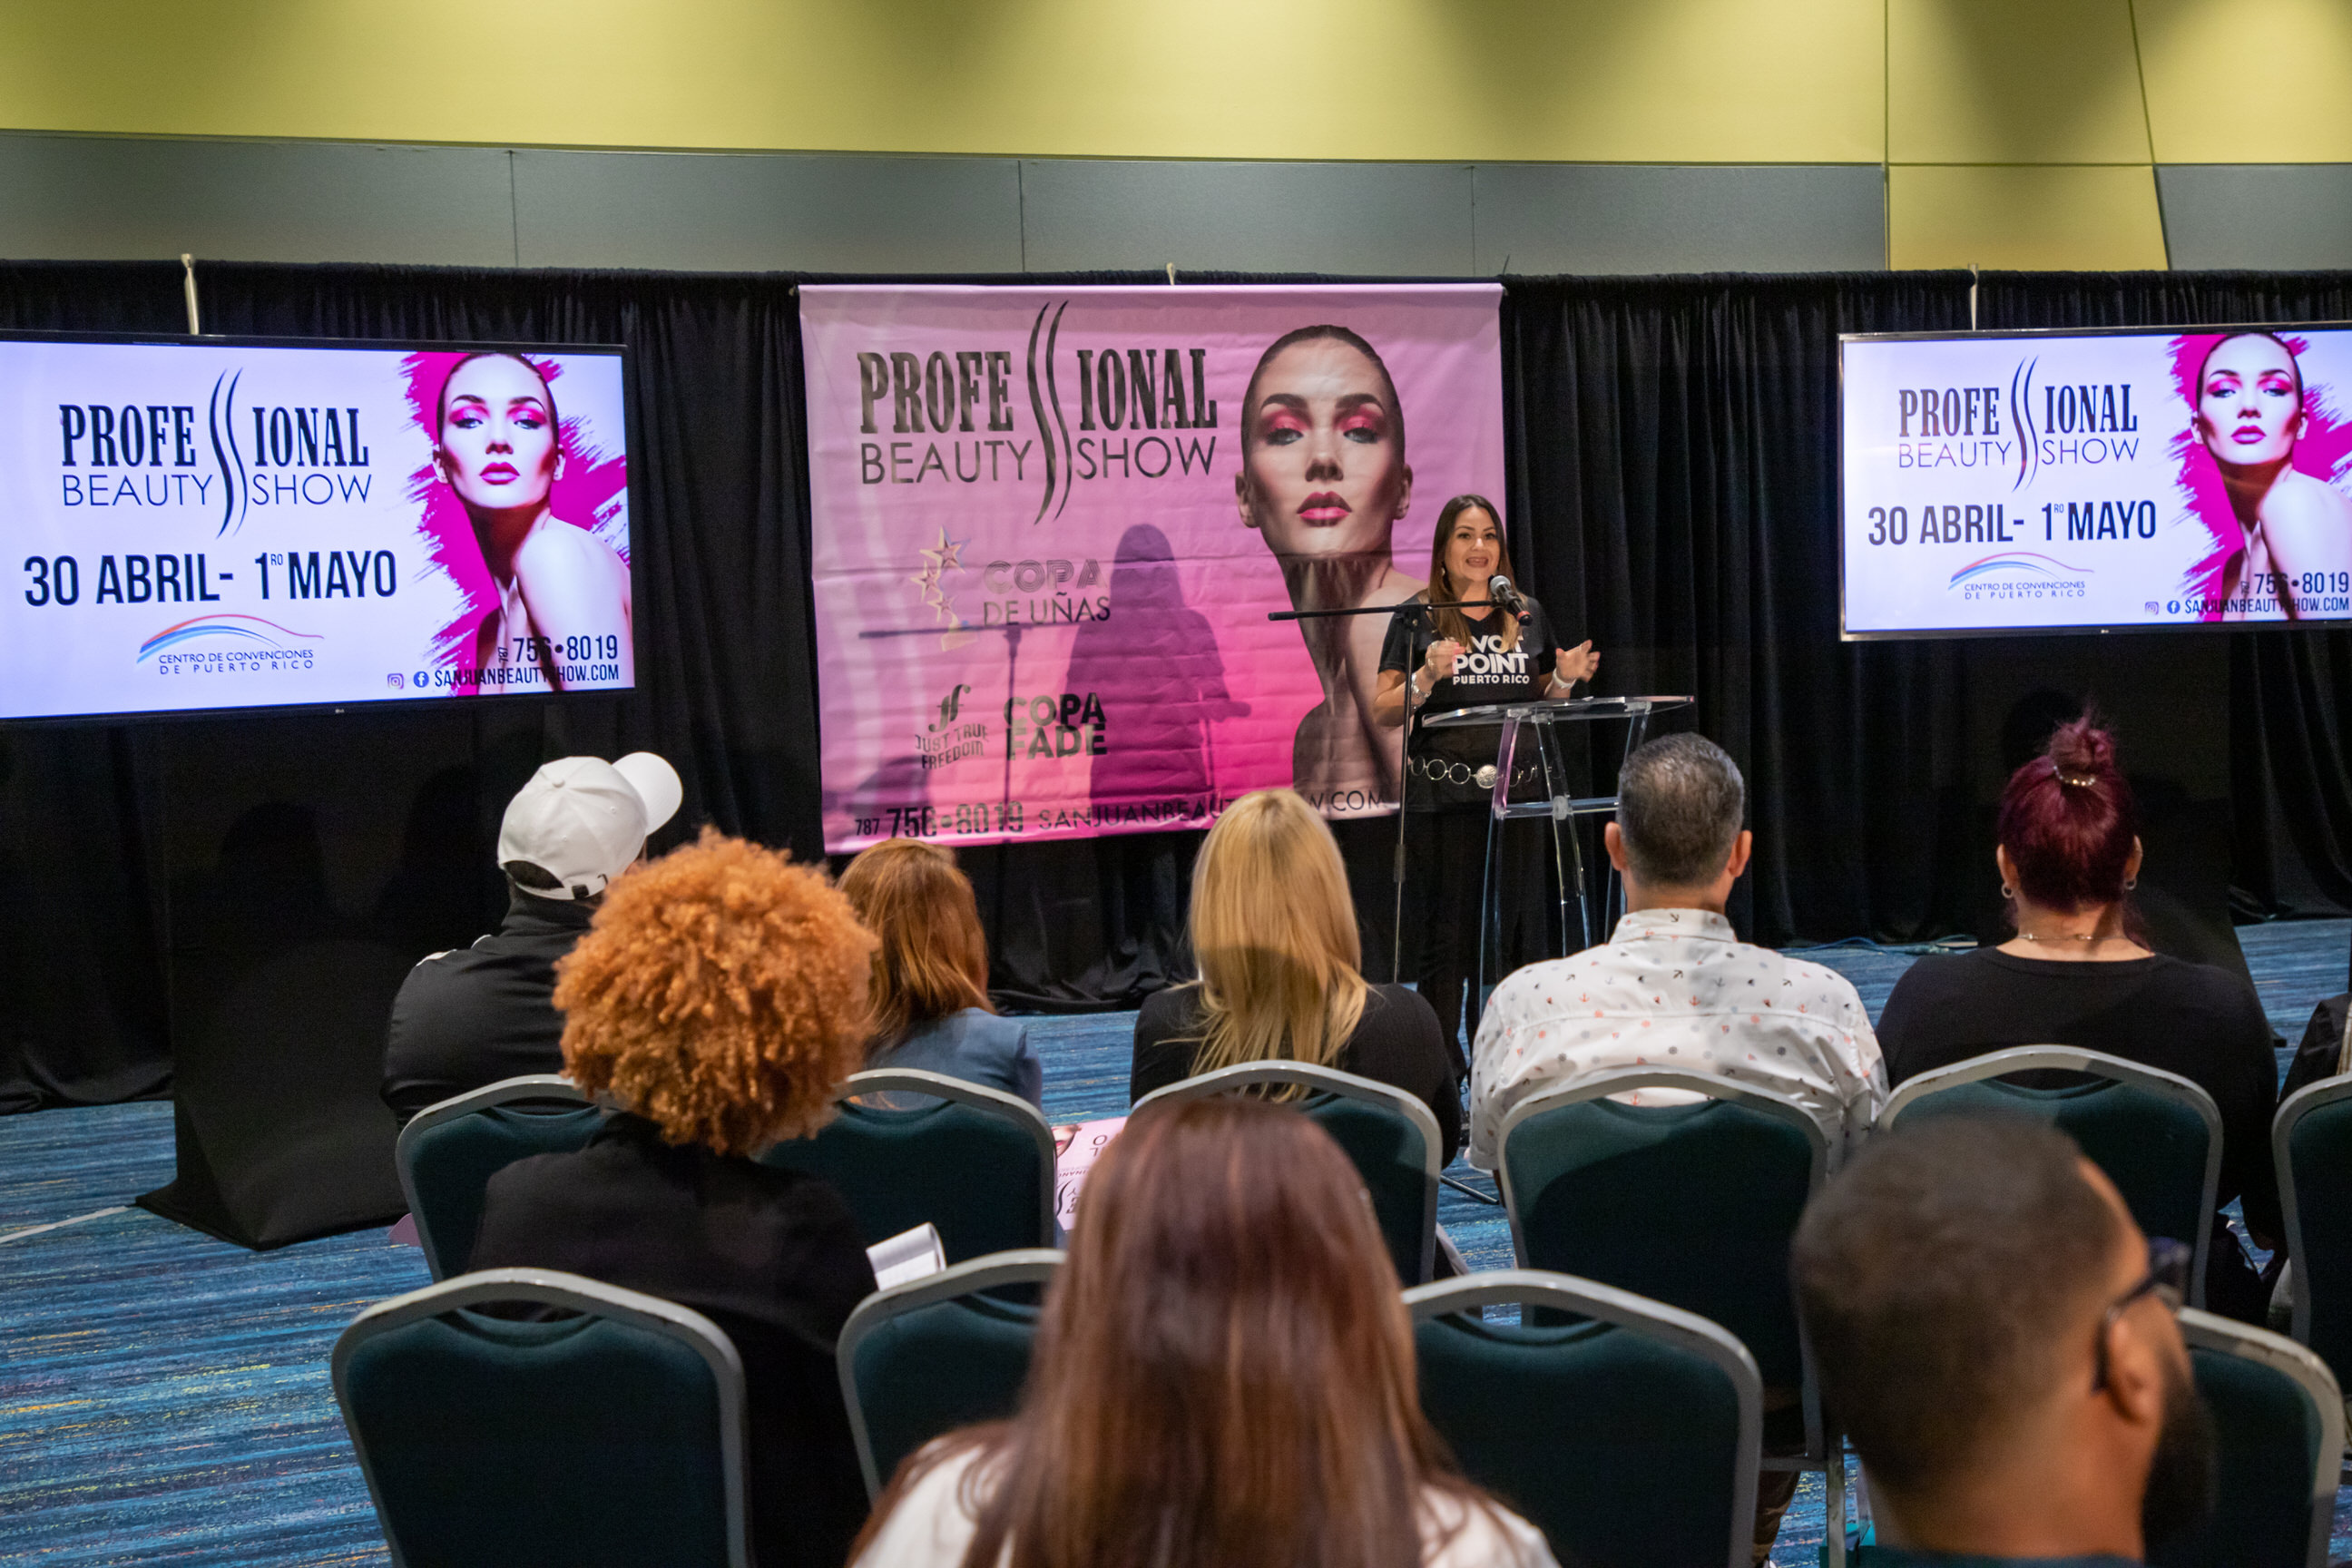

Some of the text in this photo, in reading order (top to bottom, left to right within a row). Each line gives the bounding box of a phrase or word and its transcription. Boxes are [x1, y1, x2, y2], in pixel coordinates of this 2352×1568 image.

[860, 436, 1217, 485] BEAUTY SHOW
[1899, 437, 2140, 468] BEAUTY SHOW
[63, 473, 372, 506] BEAUTY SHOW
[1868, 505, 1908, 546] 30
[2067, 500, 2156, 541] MAYO
[24, 554, 80, 607] 30
[288, 549, 397, 599] MAYO
[984, 559, 1109, 594] COPA
[1965, 581, 2085, 591] CENTRO DE CONVENCIONES
[1965, 592, 1980, 600] DE
[1990, 590, 2043, 599] PUERTO
[2185, 596, 2350, 614] SANJUANBEAUTHOW.COM
[984, 592, 1112, 626] DE UÑAS
[1465, 634, 1524, 654] VOT
[158, 649, 314, 664] CENTRO DE CONVENCIONES
[160, 659, 314, 675] DE PUERTO RICO
[1452, 652, 1530, 675] POINT
[435, 664, 620, 688] SANJUANBEAUTHOW.COM
[1453, 674, 1531, 686] PUERTO RICO
[1004, 692, 1107, 727] COPA
[1005, 723, 1108, 761] FADE
[855, 818, 880, 836] 787
